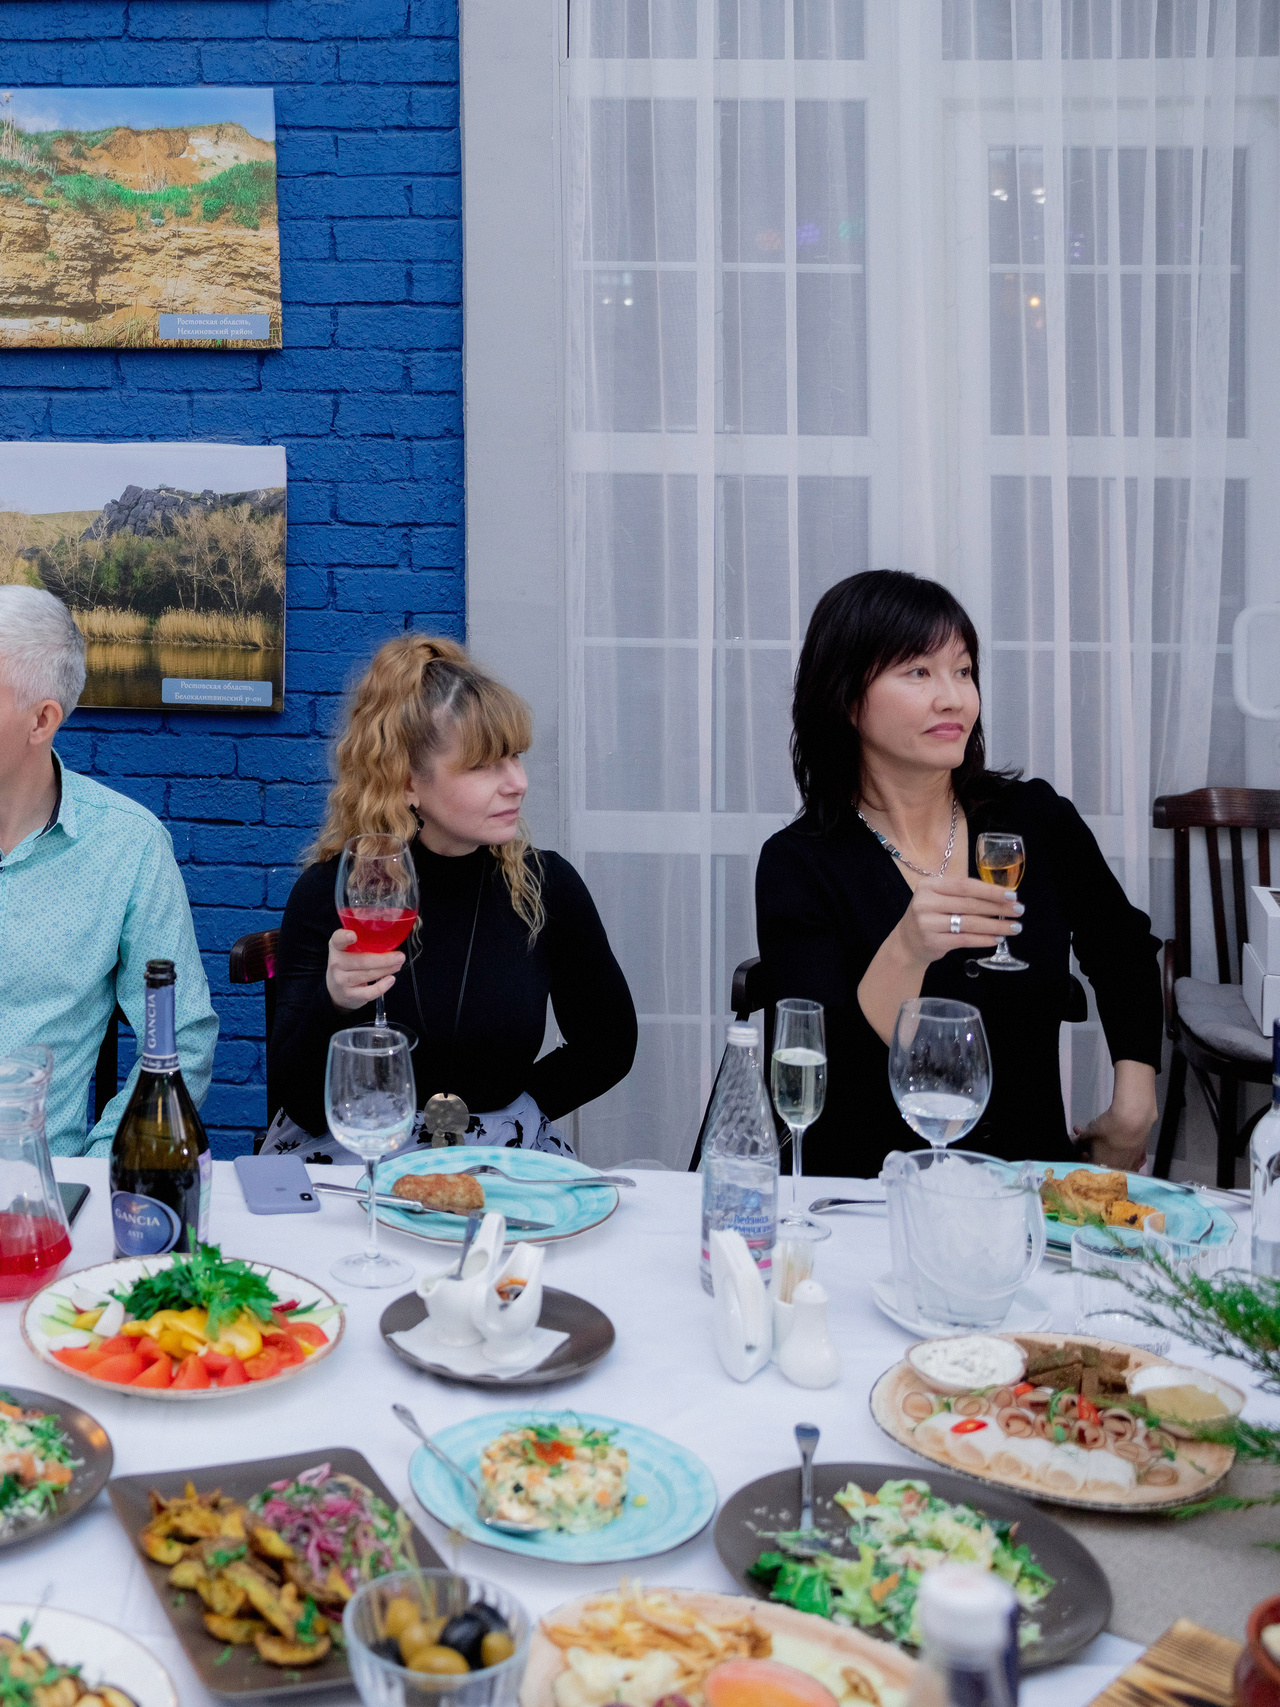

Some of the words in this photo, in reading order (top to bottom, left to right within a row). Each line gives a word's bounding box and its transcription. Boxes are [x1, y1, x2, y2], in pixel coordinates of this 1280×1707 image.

[177, 317, 218, 325] Ростовская
[219, 317, 251, 326] область,
[177, 327, 229, 335] Неклиновский
[230, 328, 253, 337] район
[180, 681, 221, 690] Ростовская
[222, 682, 254, 692] область,
[245, 696, 262, 704] р-он
[147, 993, 157, 1049] GANCIA
[114, 1207, 160, 1227] GANCIA
